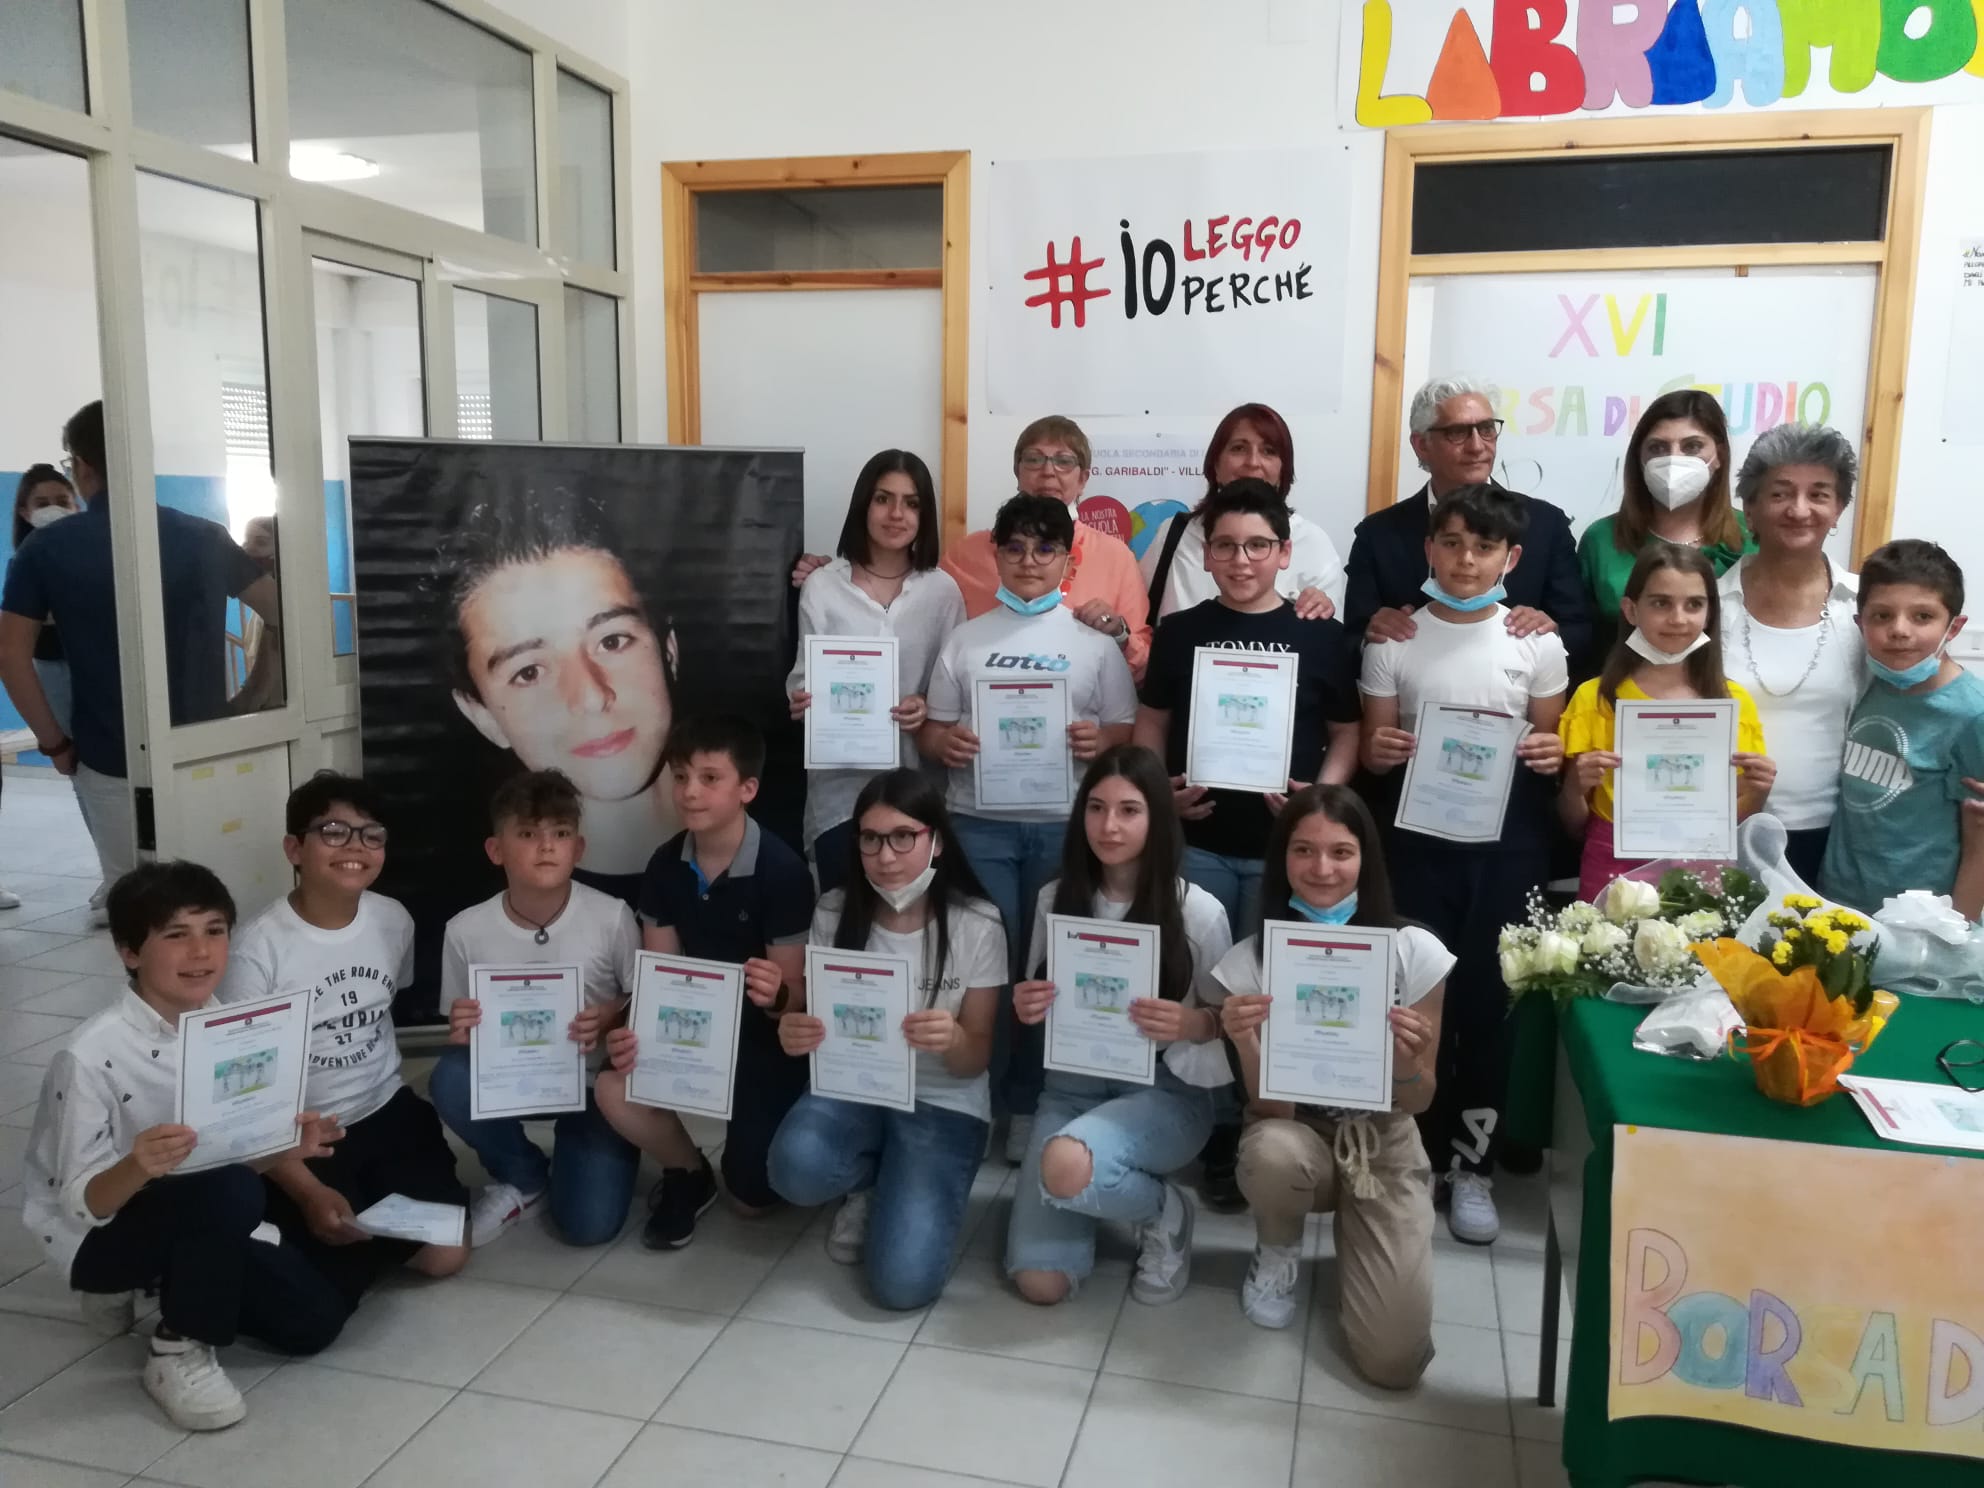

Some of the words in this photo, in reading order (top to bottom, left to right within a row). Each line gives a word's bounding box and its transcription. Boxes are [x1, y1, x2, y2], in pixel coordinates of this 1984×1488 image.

[1184, 215, 1302, 262] LEGGO
[1181, 262, 1314, 315] PERCHÉ
[1548, 292, 1669, 358] XVI
[1122, 449, 1187, 459] SECONDARIA
[1178, 466, 1205, 476] VILL
[1091, 507, 1117, 520] NOSTRA
[324, 969, 346, 987] THE
[351, 966, 379, 981] ROAD
[340, 990, 358, 1007] 19
[1618, 1227, 1905, 1423] BORSA
